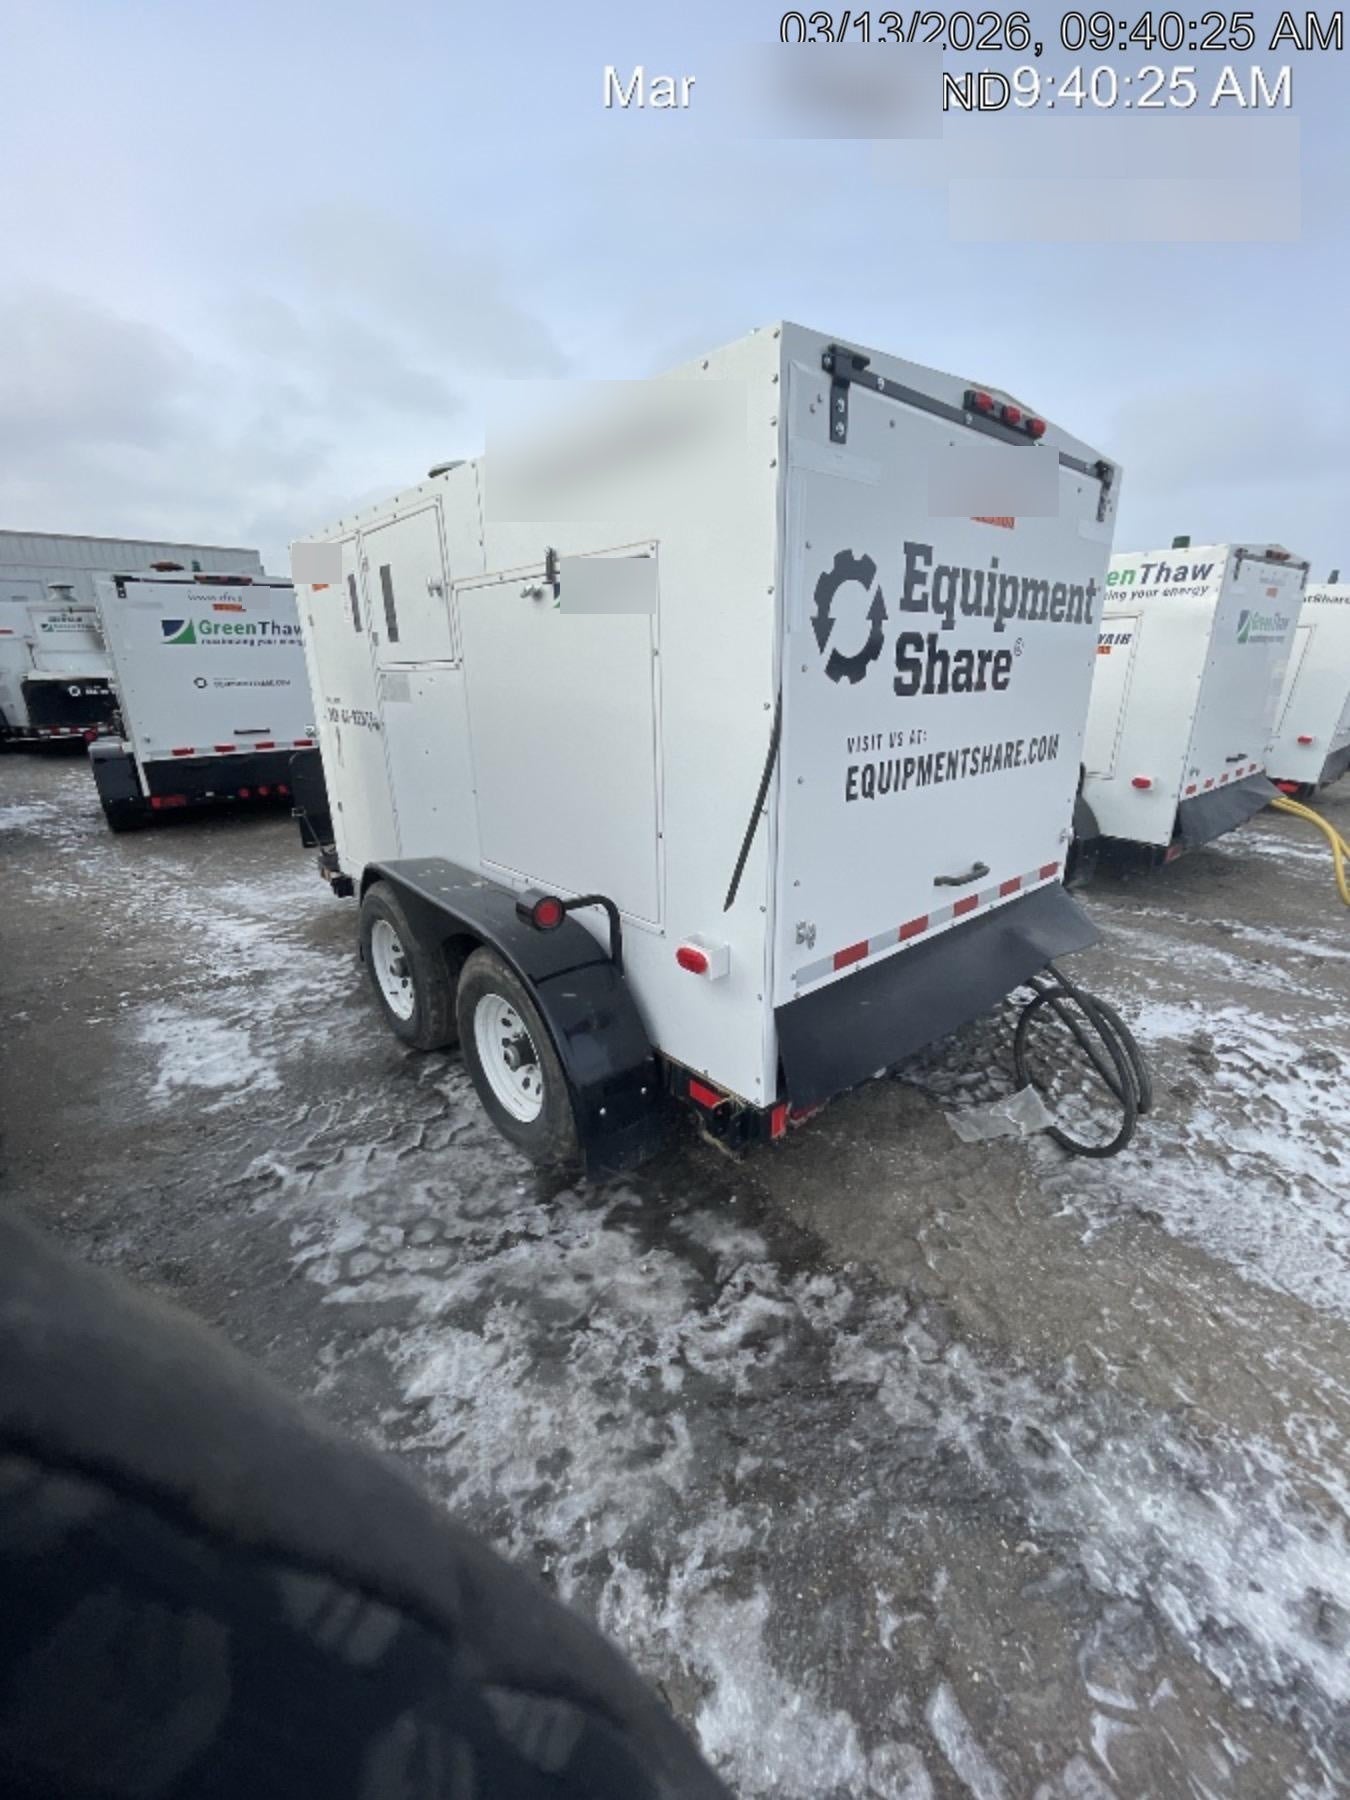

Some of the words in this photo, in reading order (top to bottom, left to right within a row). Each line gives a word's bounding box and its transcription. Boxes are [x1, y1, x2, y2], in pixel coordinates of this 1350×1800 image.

[899, 541, 1097, 632] Equipment
[1106, 561, 1215, 587] enThaw
[847, 734, 883, 754] VISIT
[889, 731, 903, 748] US
[909, 729, 928, 745] AT:
[845, 733, 1060, 802] EQUIPMENTSHARE.COM
